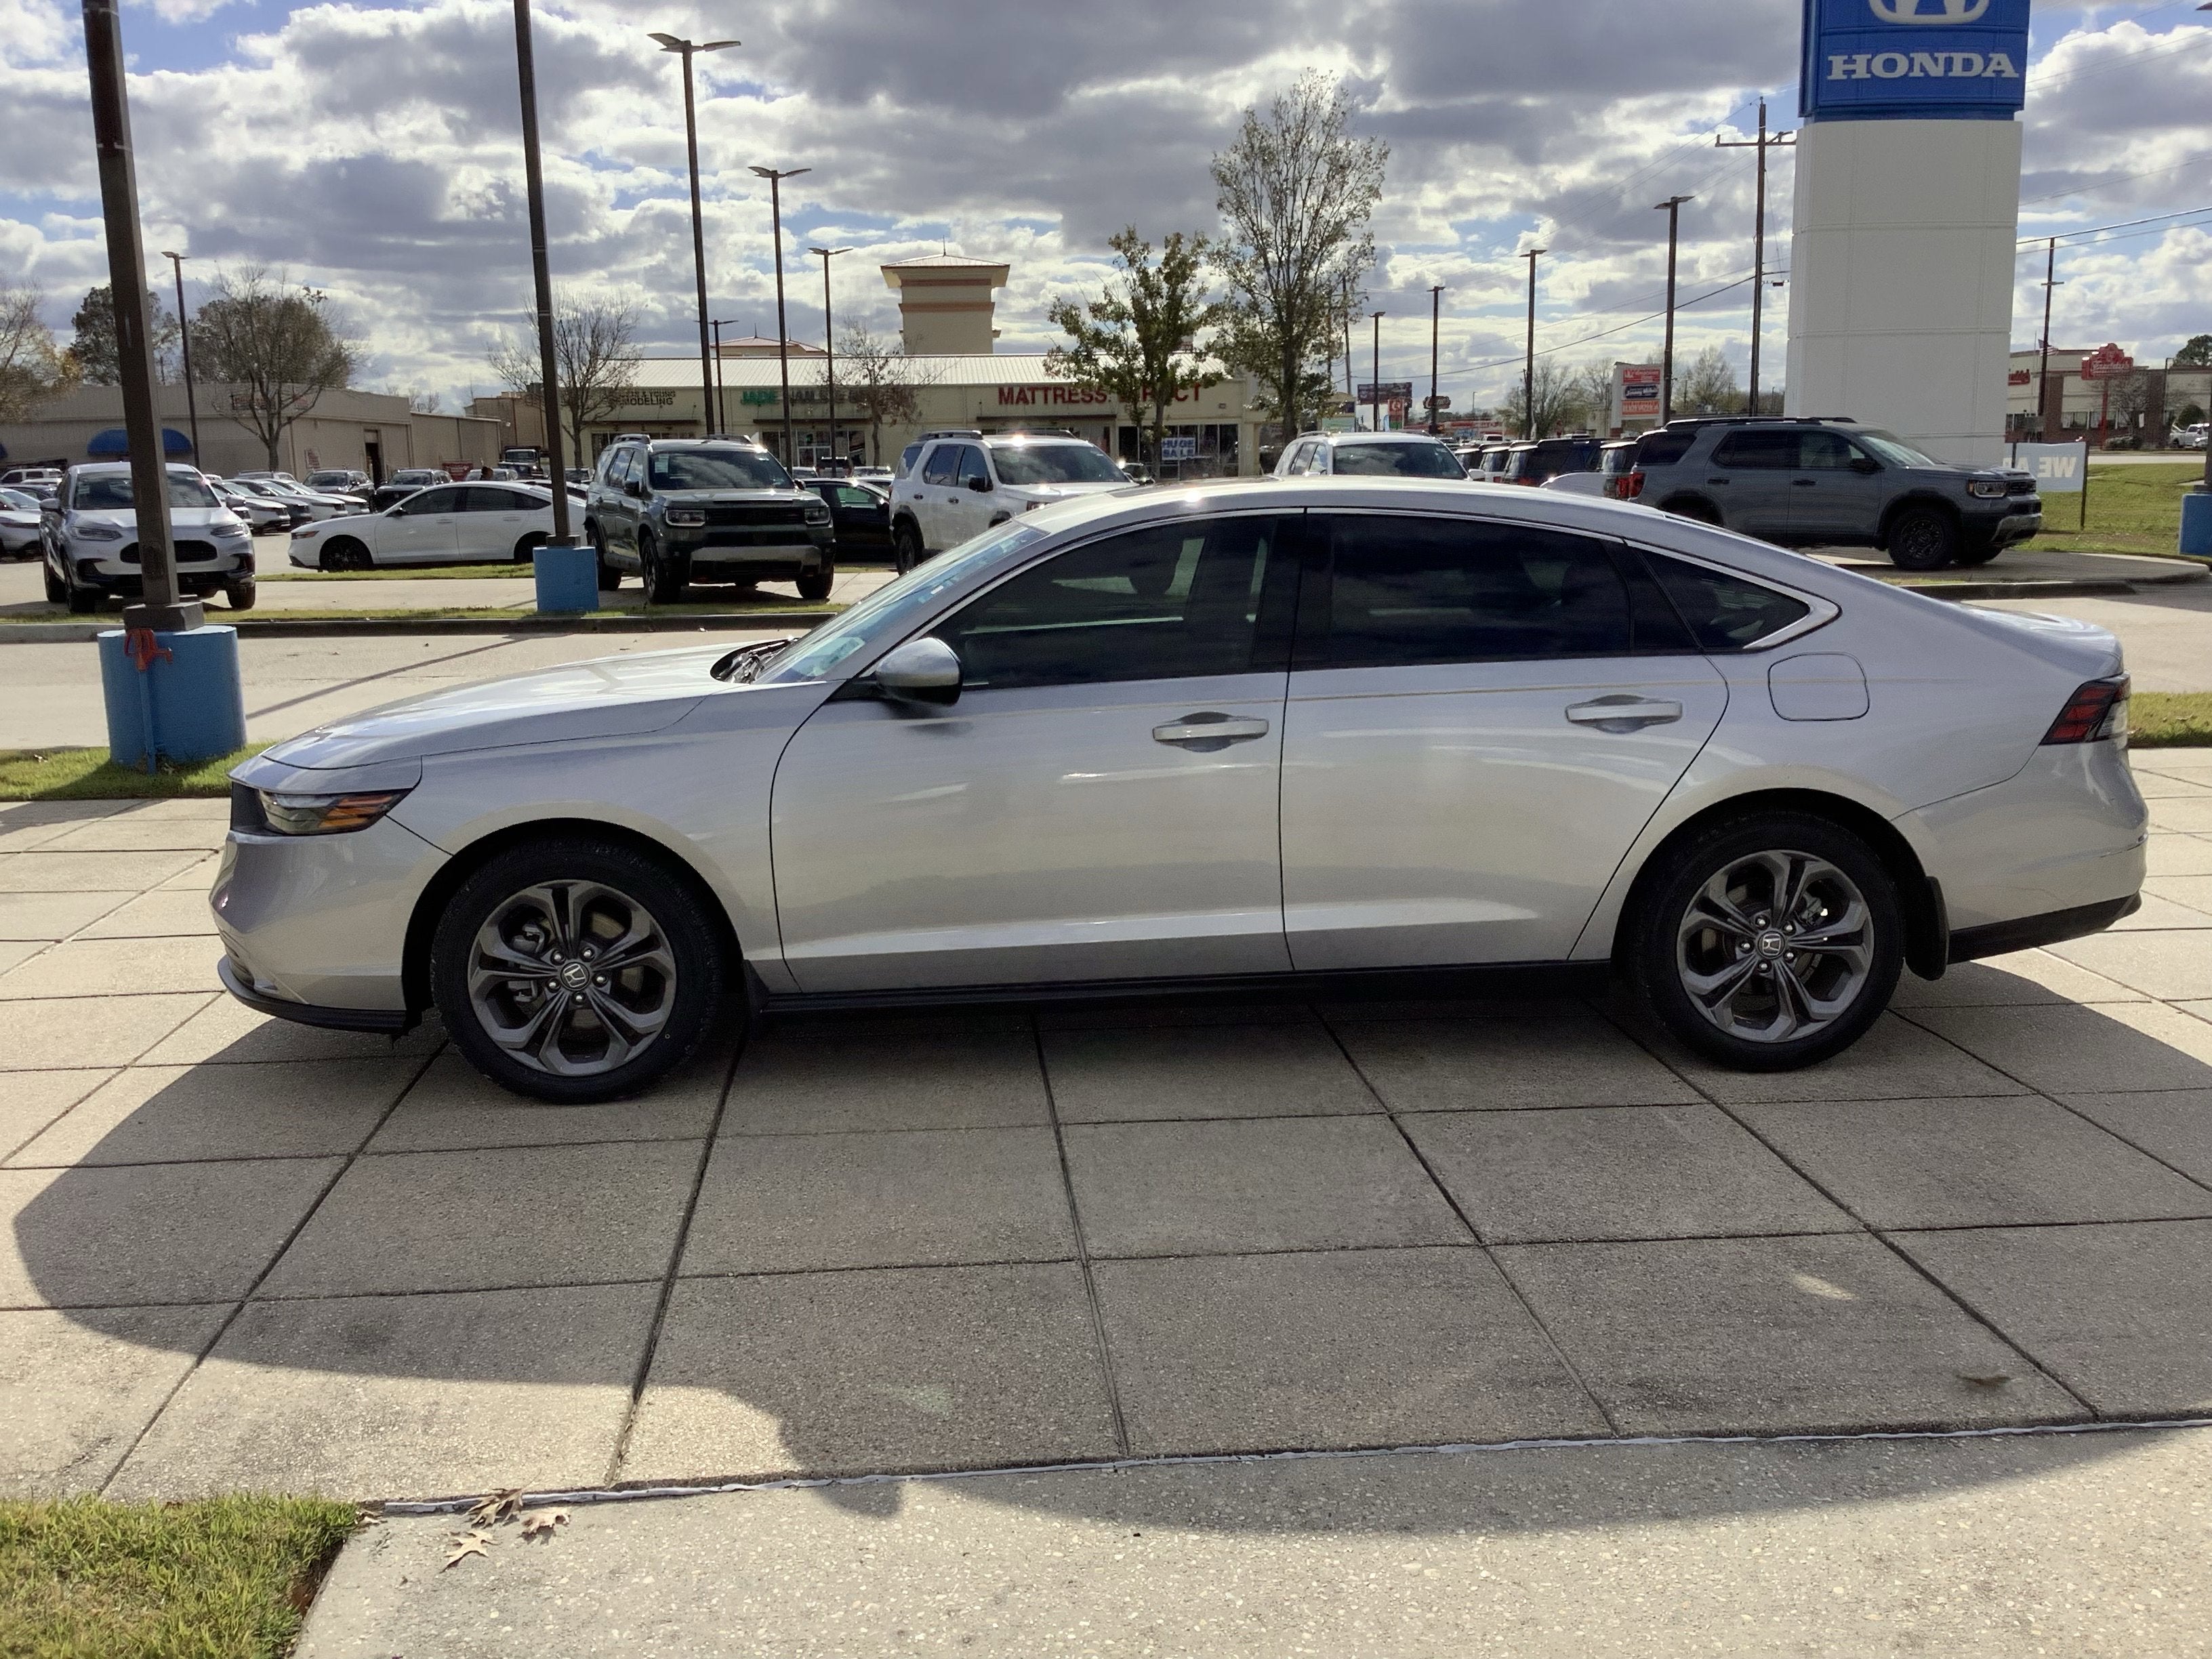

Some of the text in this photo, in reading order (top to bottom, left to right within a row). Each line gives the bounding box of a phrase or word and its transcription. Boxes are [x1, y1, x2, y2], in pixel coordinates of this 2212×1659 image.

[1828, 53, 2019, 80] HONDA
[998, 386, 1108, 405] MATTRESS
[1162, 440, 1194, 448] HUGE
[1163, 449, 1193, 457] SALE
